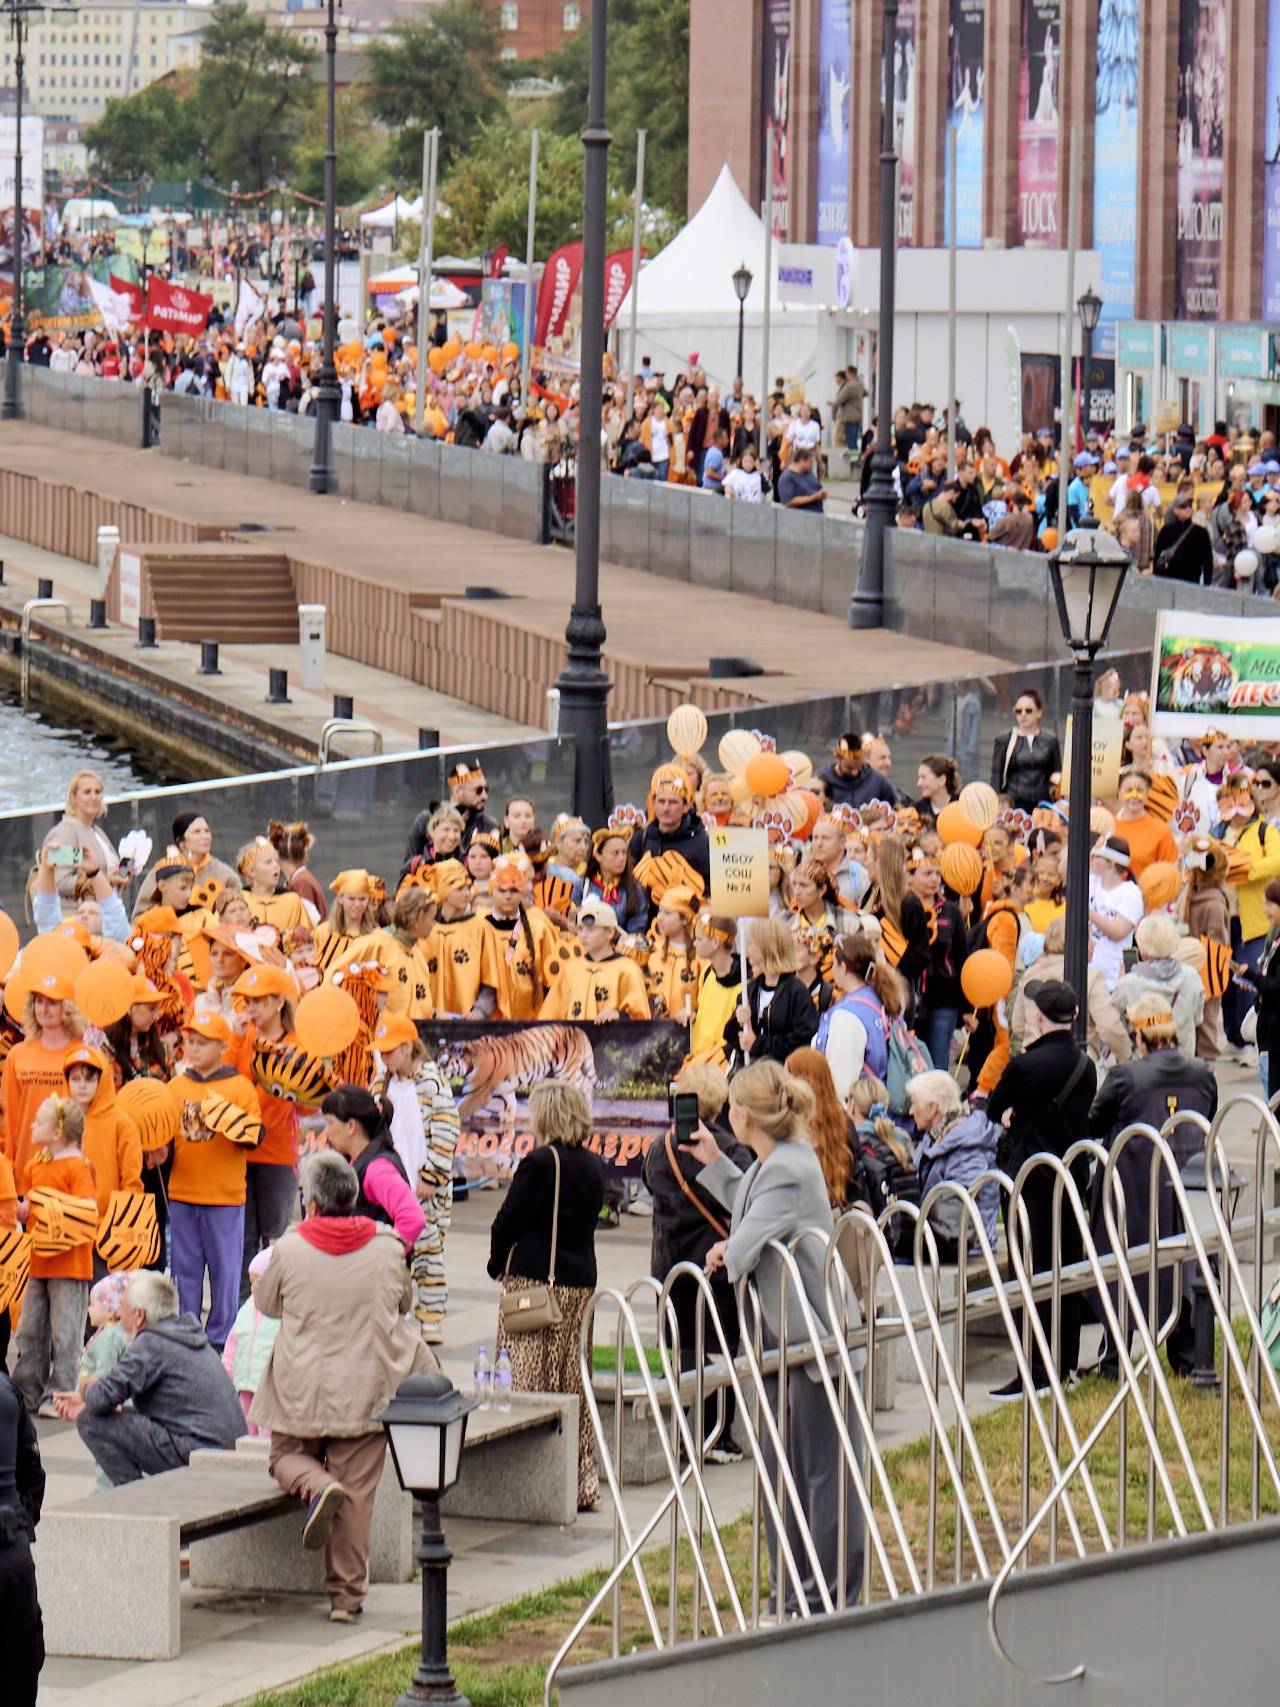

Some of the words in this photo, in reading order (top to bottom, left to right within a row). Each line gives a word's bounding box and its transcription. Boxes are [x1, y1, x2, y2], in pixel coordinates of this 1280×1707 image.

[1020, 191, 1057, 234] ТОСК
[1228, 681, 1280, 708] ЛЕС
[1093, 740, 1108, 751] ОУ
[715, 835, 727, 846] 11
[722, 853, 754, 865] МБОУ
[725, 868, 752, 879] СОШ
[454, 1131, 535, 1159] кого
